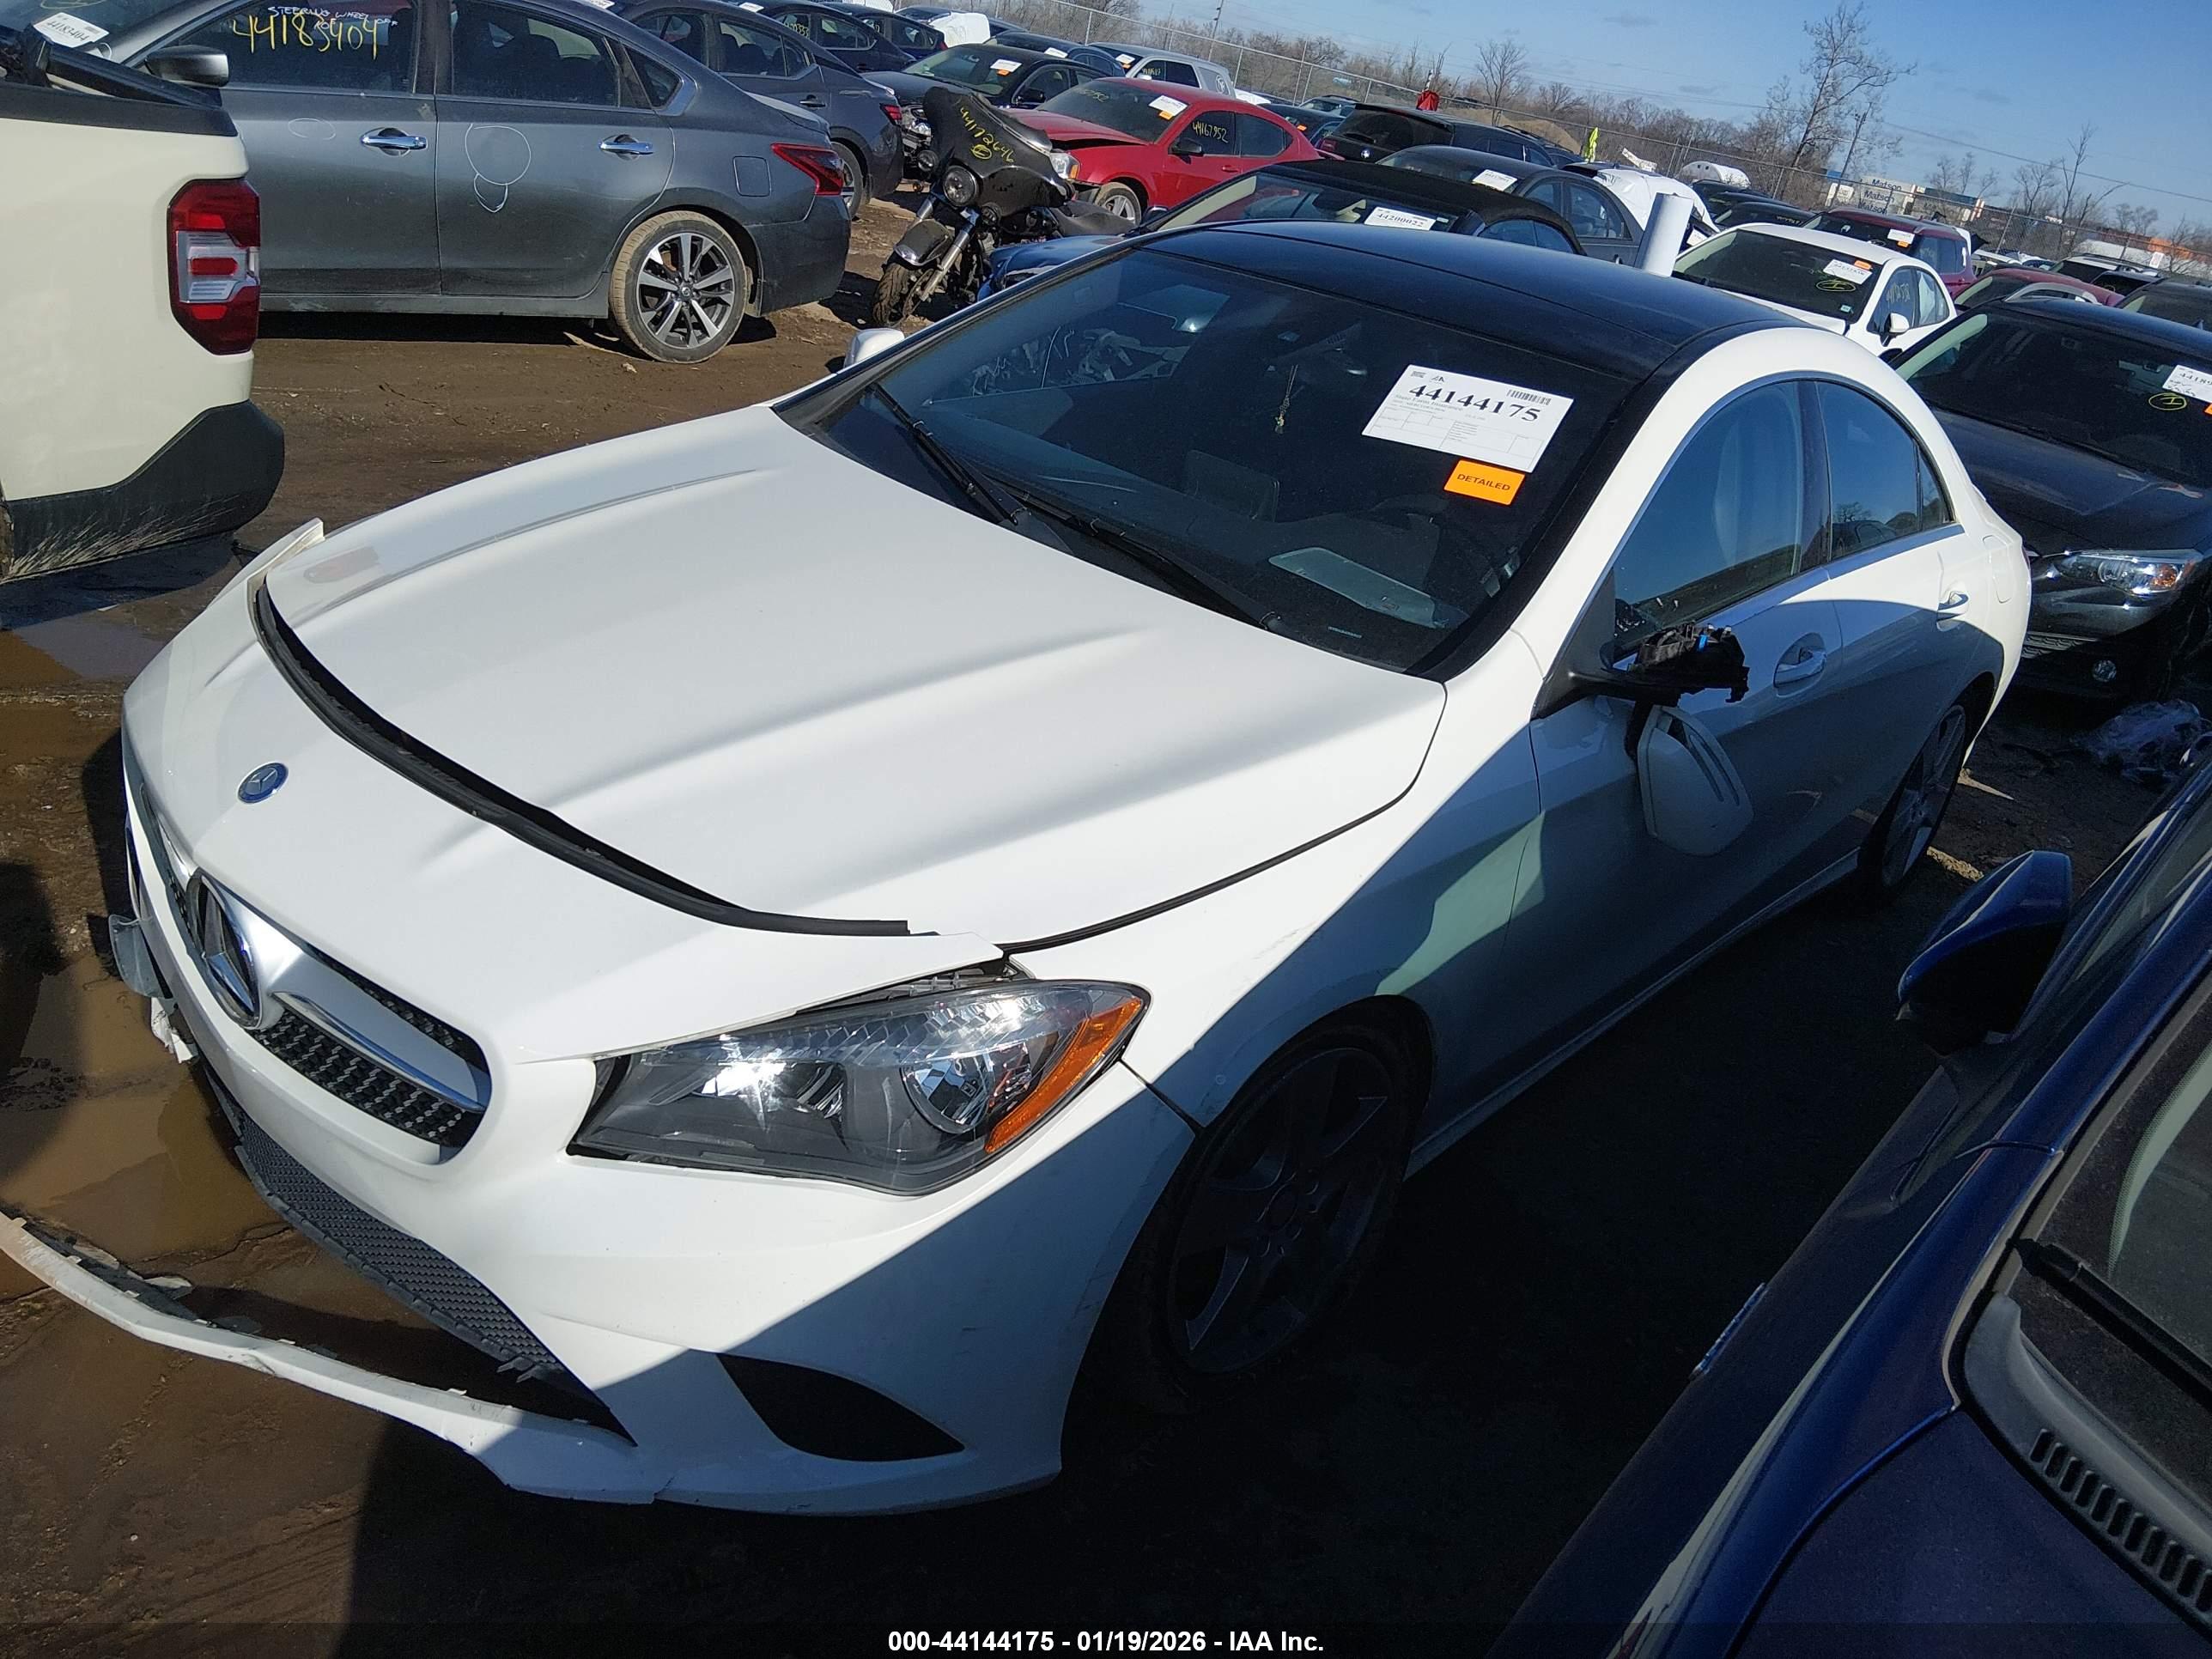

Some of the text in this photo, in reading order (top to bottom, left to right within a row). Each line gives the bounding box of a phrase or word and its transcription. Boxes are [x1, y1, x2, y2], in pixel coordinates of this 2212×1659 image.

[1192, 120, 1229, 143] 44167952
[1872, 179, 1902, 191] Matson
[1863, 190, 1895, 204] Matson
[1408, 384, 1542, 422] 44144175
[1456, 472, 1511, 492] DETAILED
